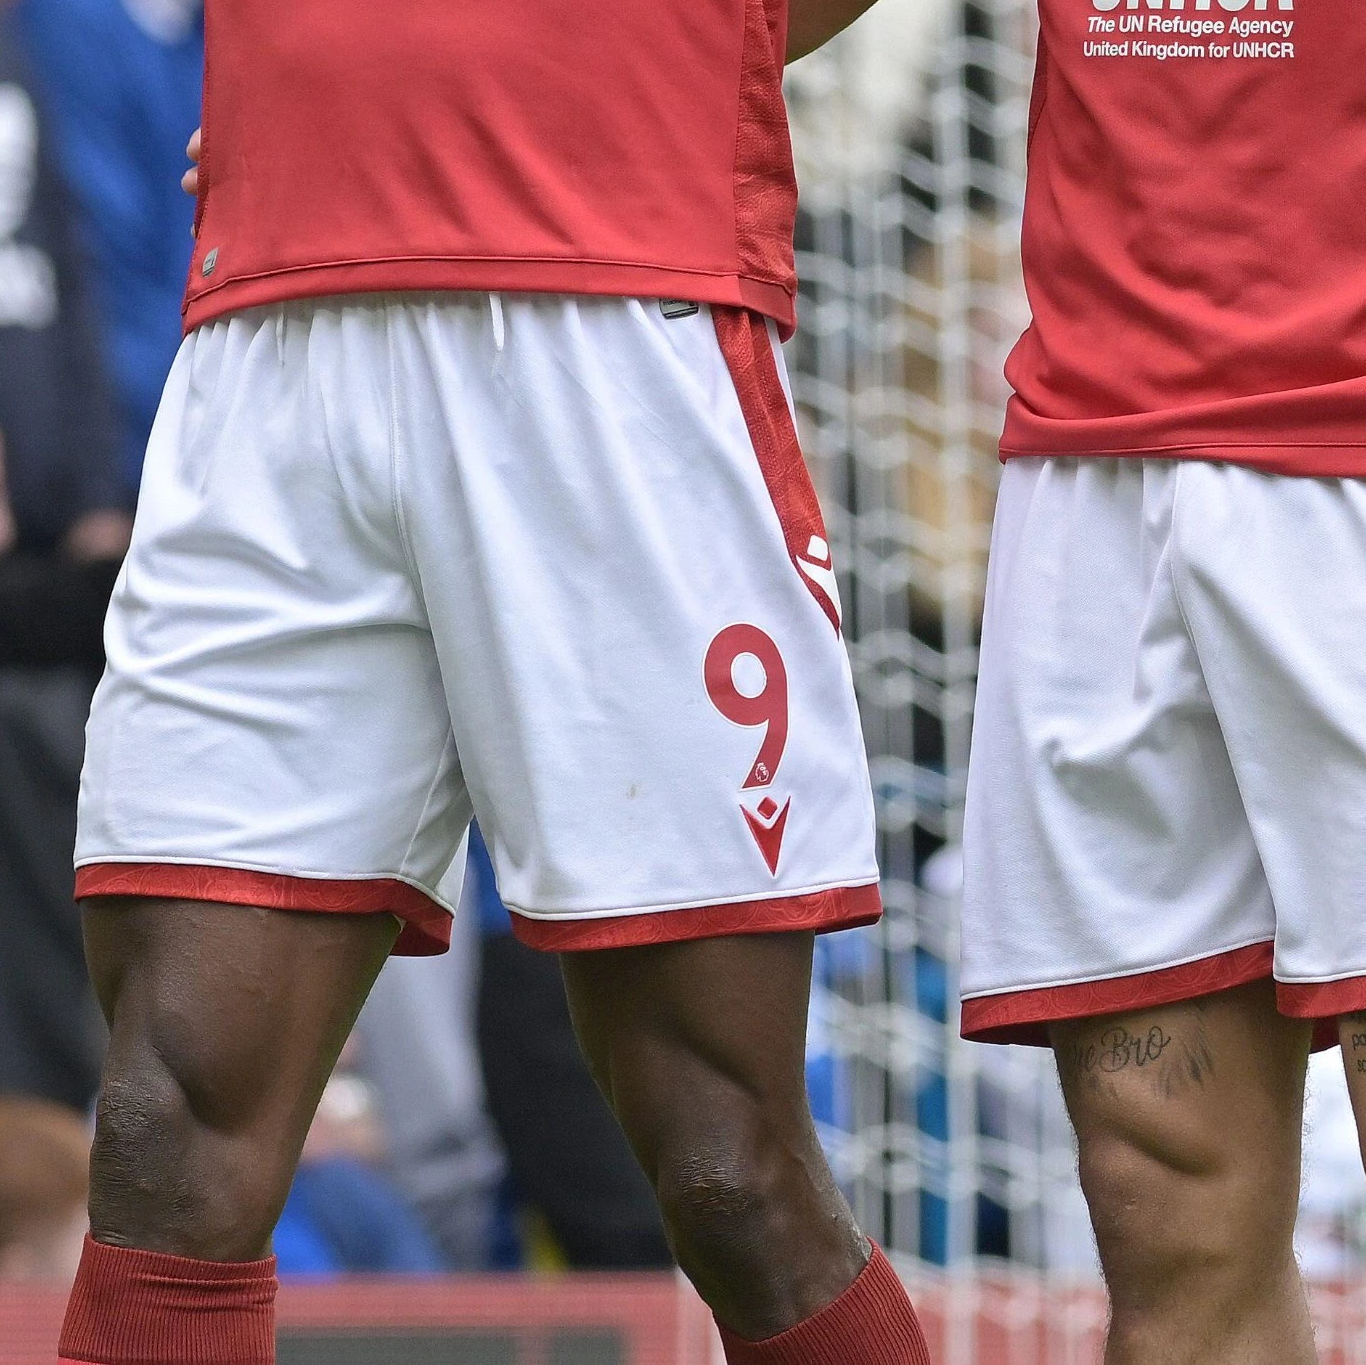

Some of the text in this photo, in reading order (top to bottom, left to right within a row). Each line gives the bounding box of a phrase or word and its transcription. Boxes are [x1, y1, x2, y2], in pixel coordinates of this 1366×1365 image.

[1087, 15, 1294, 38] The UN Refugee Agency
[1083, 40, 1295, 60] United Kingdom for UNHCR
[702, 621, 789, 793] 9
